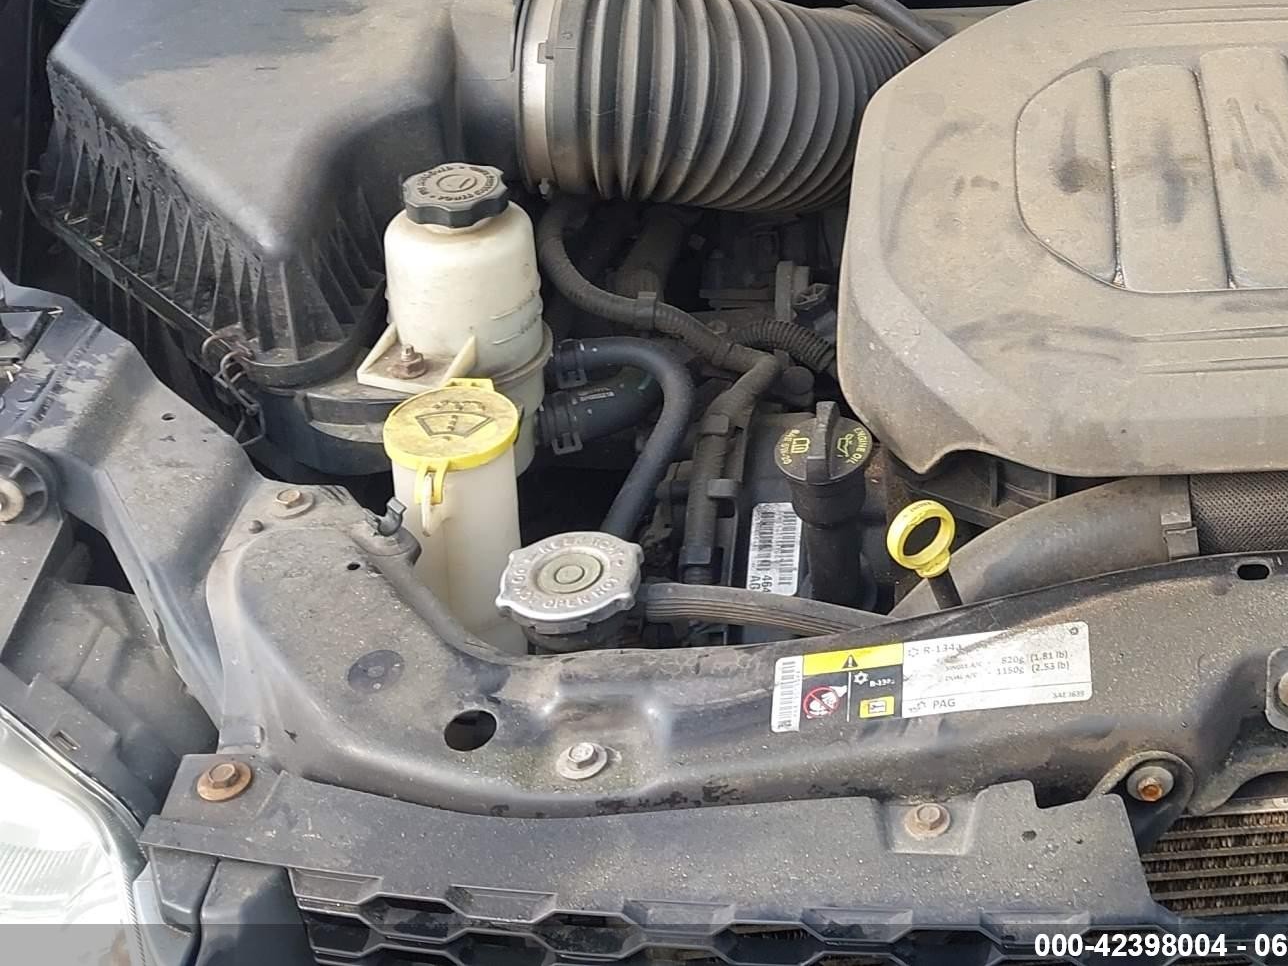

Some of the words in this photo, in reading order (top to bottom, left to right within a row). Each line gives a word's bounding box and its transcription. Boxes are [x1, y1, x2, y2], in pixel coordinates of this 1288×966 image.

[853, 427, 868, 453] ENGINE
[846, 452, 863, 465] OIL
[932, 698, 956, 708] PAG
